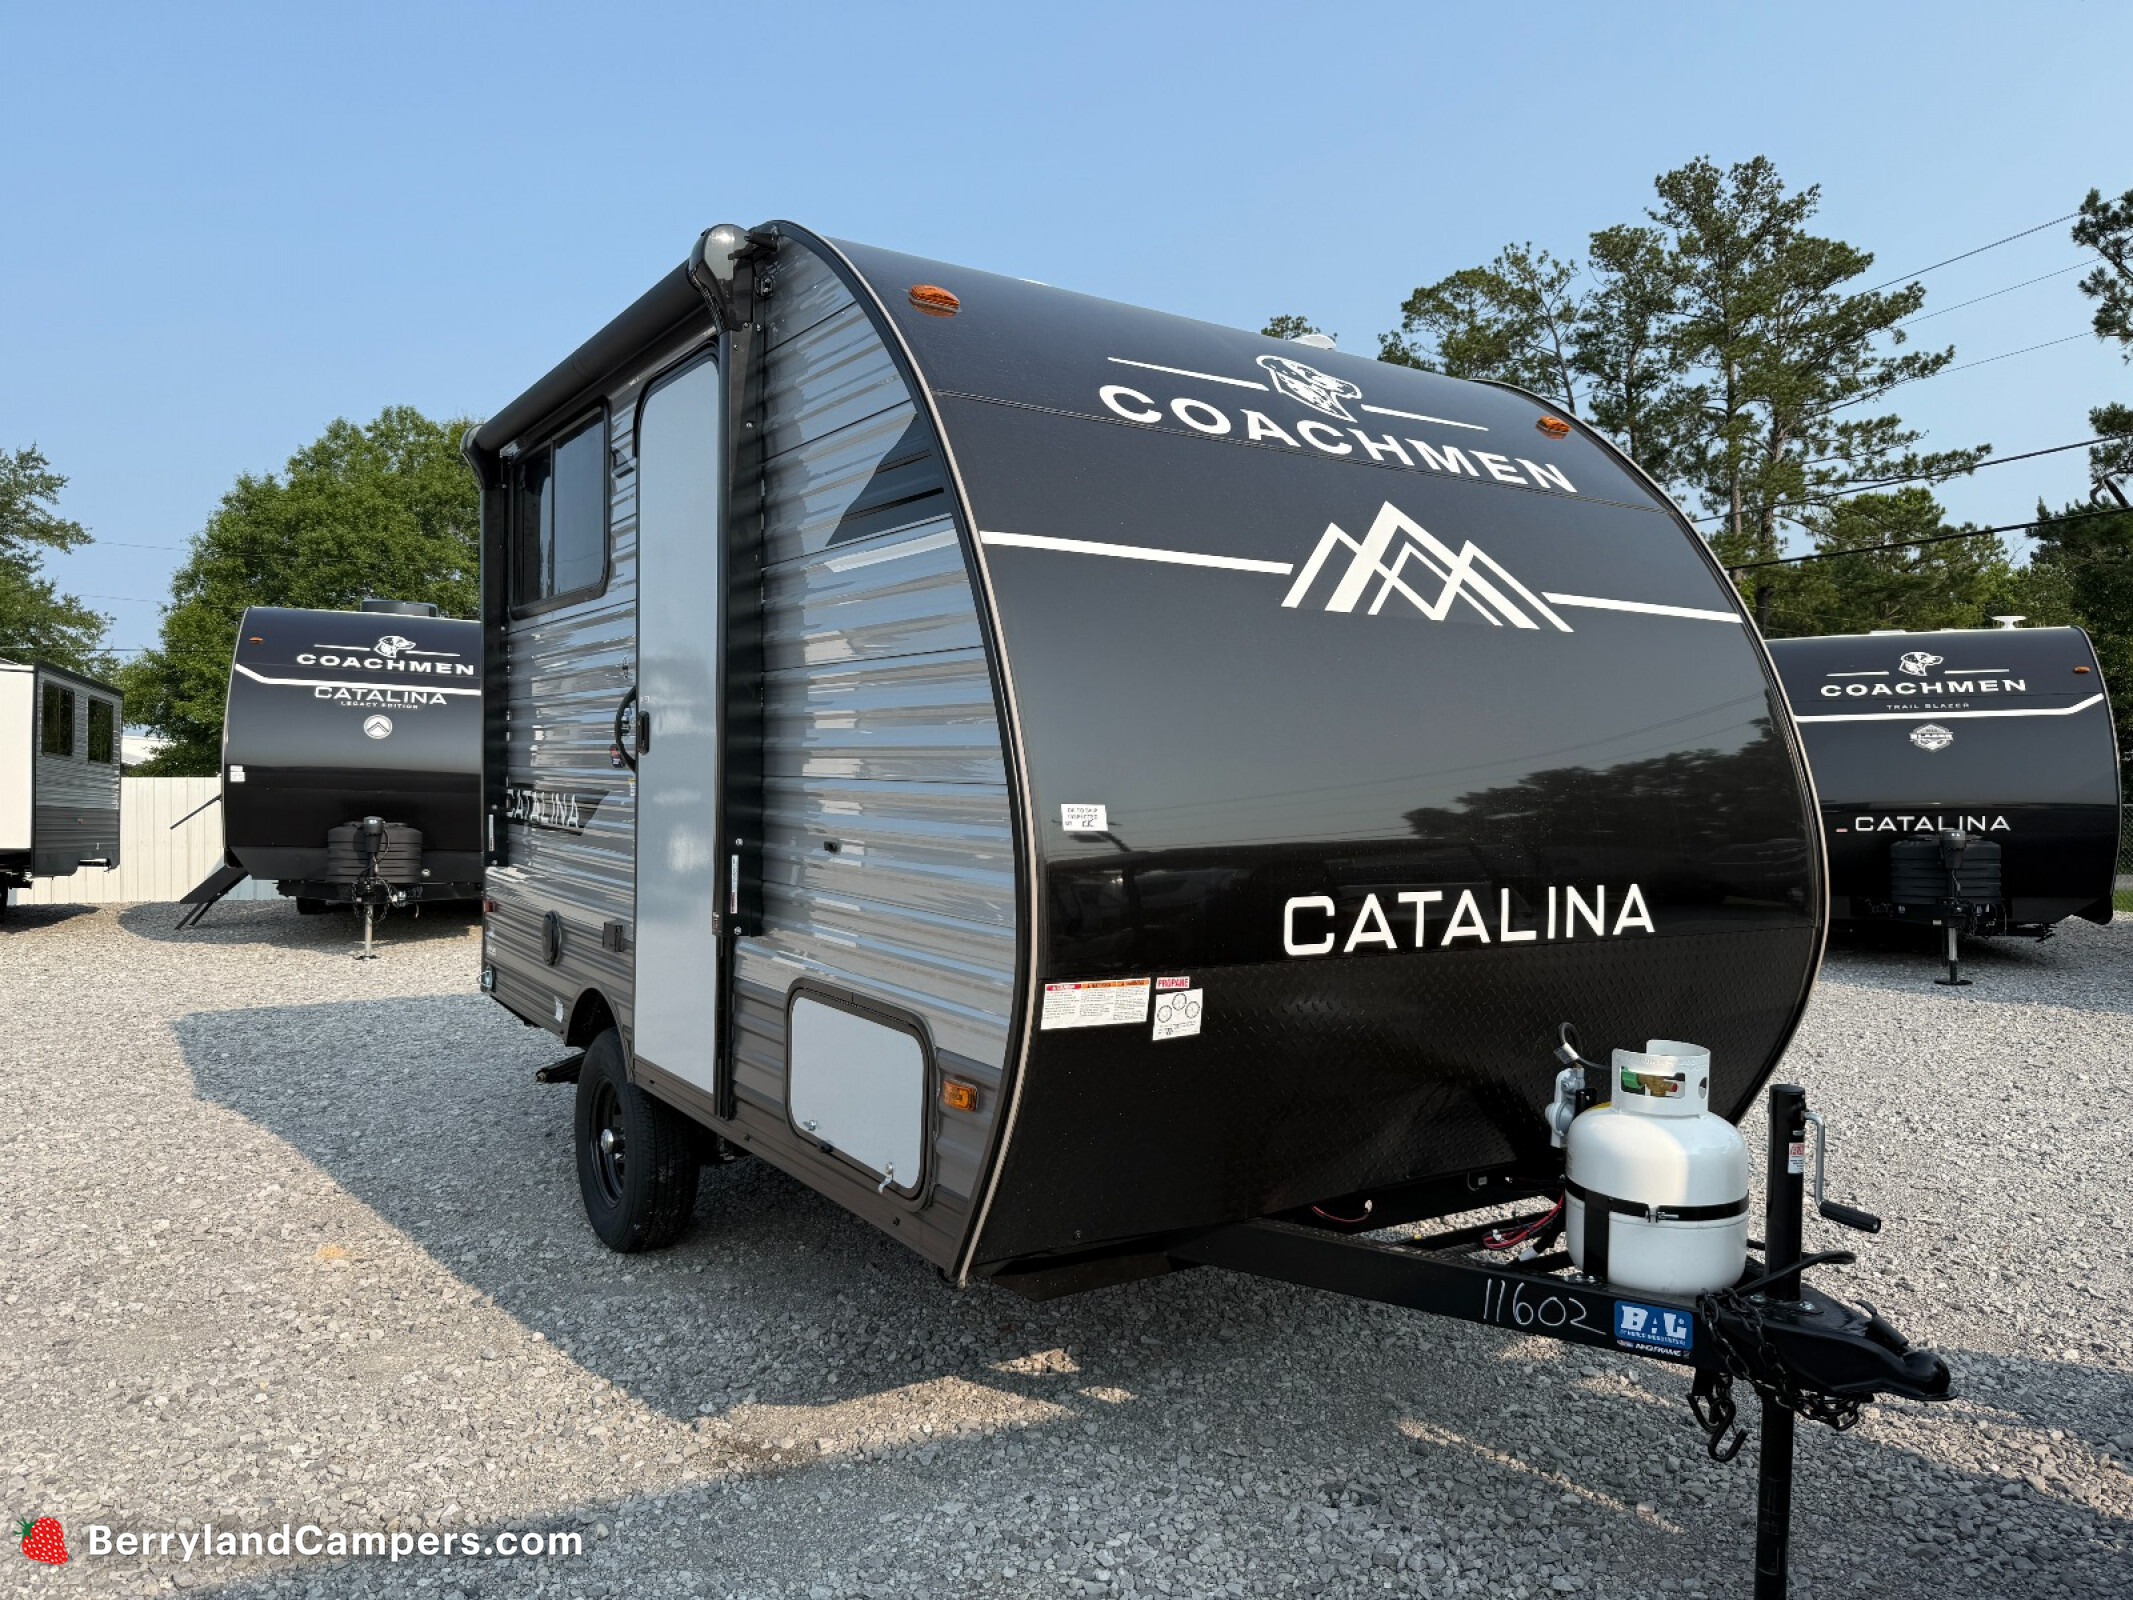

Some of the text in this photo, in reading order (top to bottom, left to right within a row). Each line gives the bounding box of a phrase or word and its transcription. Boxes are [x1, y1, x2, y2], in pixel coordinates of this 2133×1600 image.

[1099, 384, 1578, 493] COACHMEN
[296, 653, 474, 676] COACHMEN
[314, 686, 448, 705] CATALINA
[1820, 679, 2026, 697] COACHMEN
[506, 788, 579, 829] CATALINA
[1855, 815, 2011, 832] CATALINA
[1283, 883, 1655, 956] CATALINA
[1158, 978, 1189, 988] PROPANE
[1483, 1278, 1607, 1335] 11602
[1620, 1305, 1687, 1339] BAL
